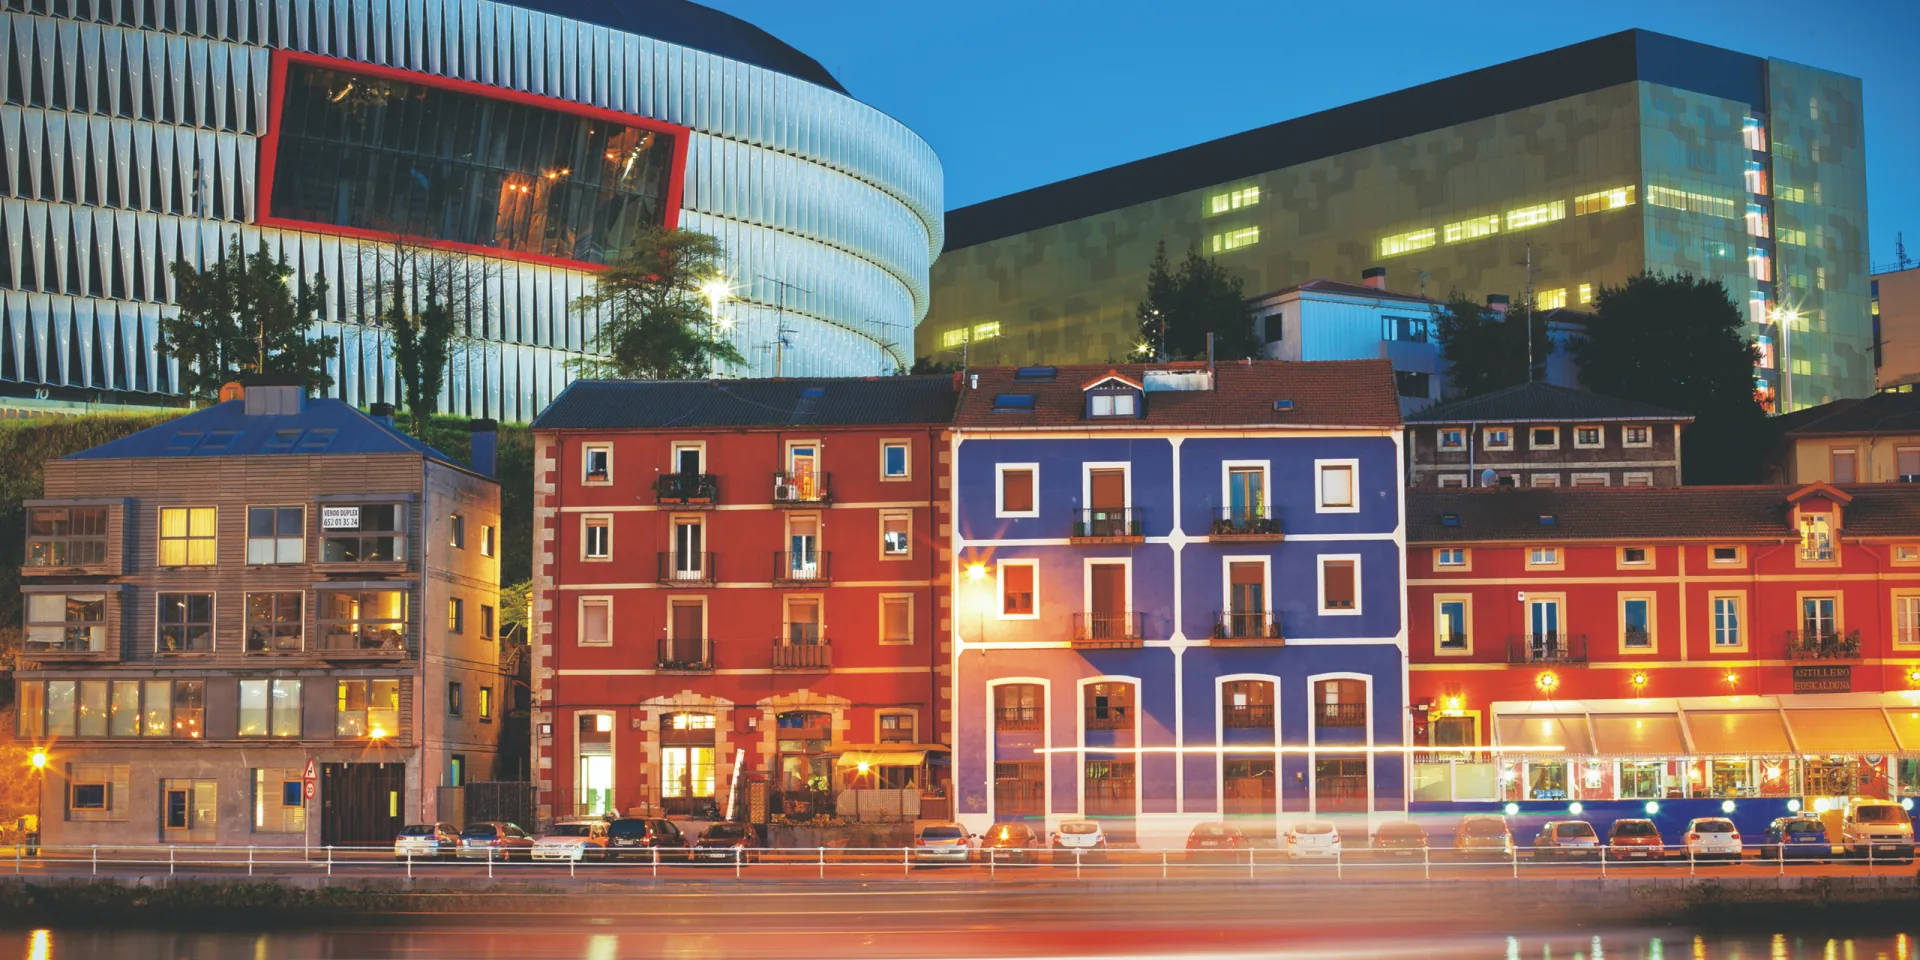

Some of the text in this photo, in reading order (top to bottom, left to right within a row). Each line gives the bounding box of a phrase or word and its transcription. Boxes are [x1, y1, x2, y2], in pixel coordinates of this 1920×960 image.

[35, 388, 49, 400] 10
[1796, 668, 1849, 677] ASTILLERO
[1795, 681, 1850, 690] EUSKALDUNA
